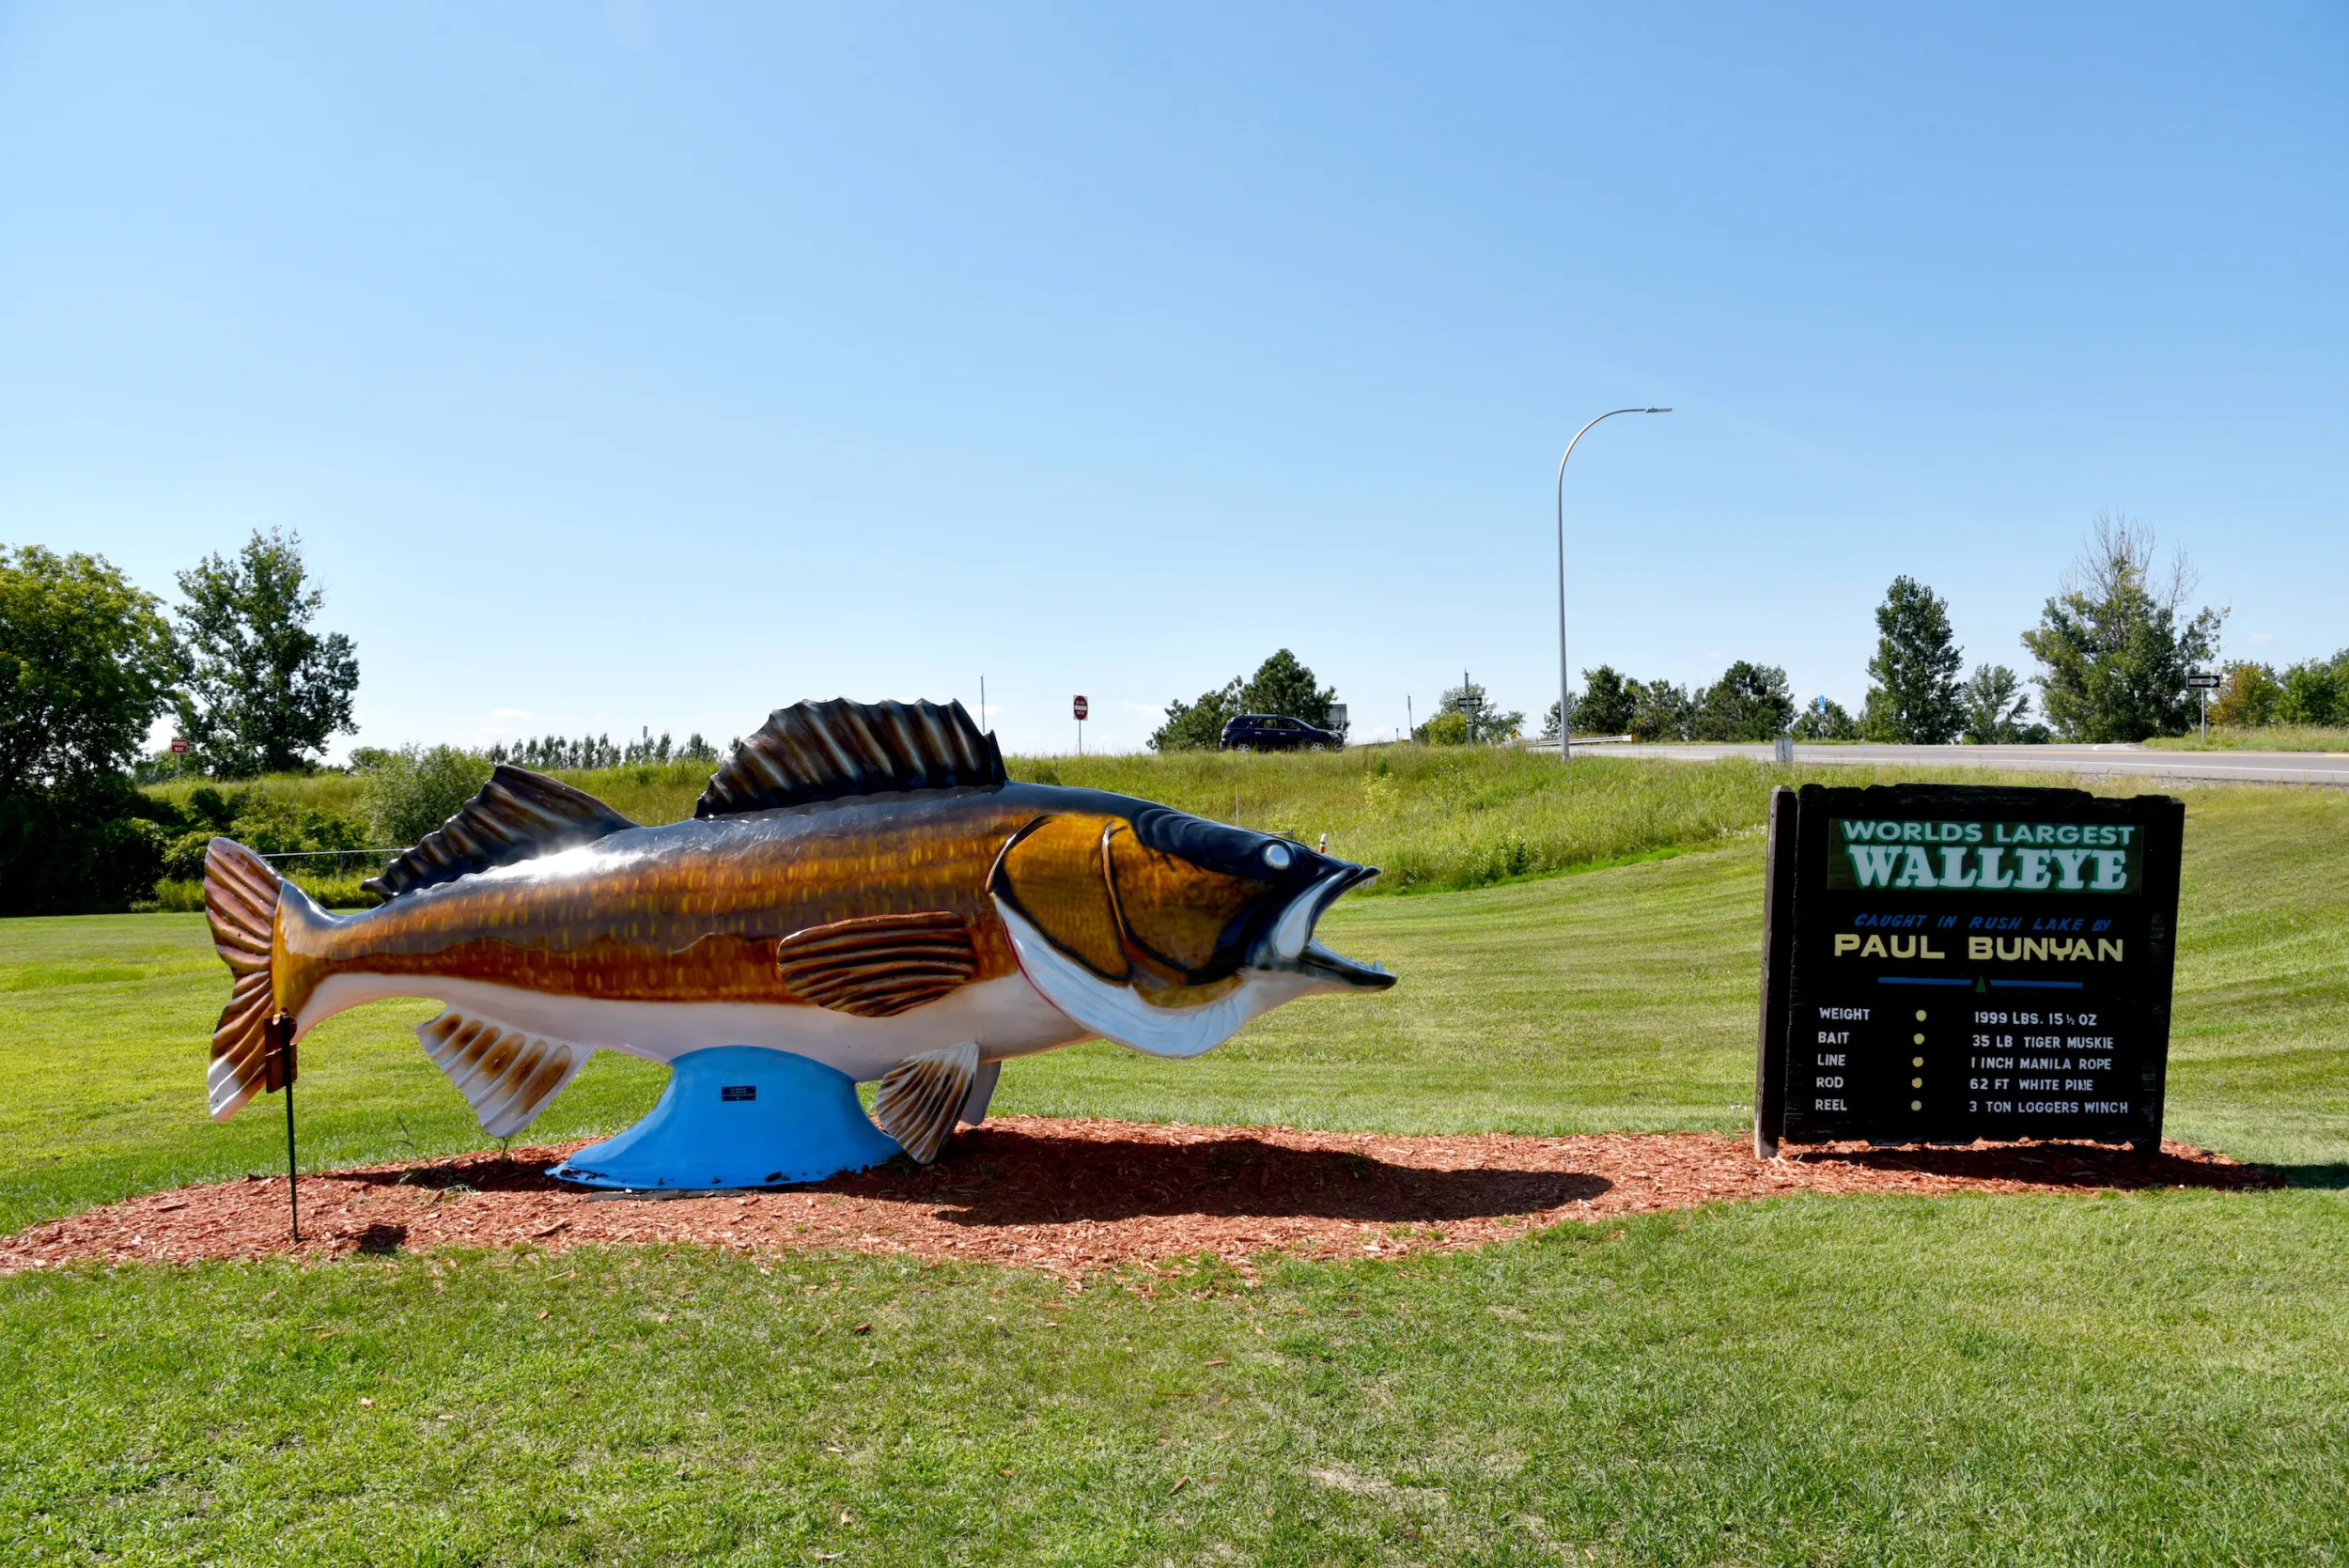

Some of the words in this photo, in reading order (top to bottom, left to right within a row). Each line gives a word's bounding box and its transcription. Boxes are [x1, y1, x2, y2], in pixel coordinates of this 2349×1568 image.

[1842, 820, 1983, 843] WORLDS
[1994, 823, 2135, 846] LARGEST
[1846, 844, 2127, 891] WALLEYE
[1854, 913, 1927, 928] CAUGHT
[1937, 915, 1957, 929] IN
[1968, 916, 2022, 930] RUSH
[2032, 918, 2084, 931] LAKE
[2092, 919, 2112, 932] BY
[1834, 933, 1946, 959] PAUL
[1968, 936, 2123, 962] BUNYAN
[1819, 1007, 1870, 1020] WEIGHT
[1974, 1011, 2008, 1024] 1999
[2013, 1012, 2044, 1025] LBS.
[2078, 1014, 2097, 1026] OZ
[1817, 1032, 1849, 1044] BAIT
[1972, 1034, 1990, 1048] 35
[1996, 1035, 2014, 1048] LB
[2023, 1036, 2061, 1048] TIGER
[2066, 1036, 2114, 1049] MUSKIE
[1817, 1053, 1846, 1066] LINE
[1981, 1057, 2014, 1069] INCH
[2019, 1058, 2072, 1070] MANILA
[2078, 1058, 2112, 1070] ROPE
[1815, 1077, 1843, 1088] ROD
[1969, 1078, 1989, 1090] 62
[1994, 1079, 2010, 1090] FT
[2018, 1079, 2060, 1091] WHITE
[2064, 1079, 2093, 1091] PINE
[1814, 1098, 1848, 1111] REEL
[1968, 1100, 1978, 1112] 3
[1985, 1101, 2012, 1113] TON
[2018, 1101, 2079, 1113] LOGGERS
[2084, 1102, 2128, 1114] WINCH
